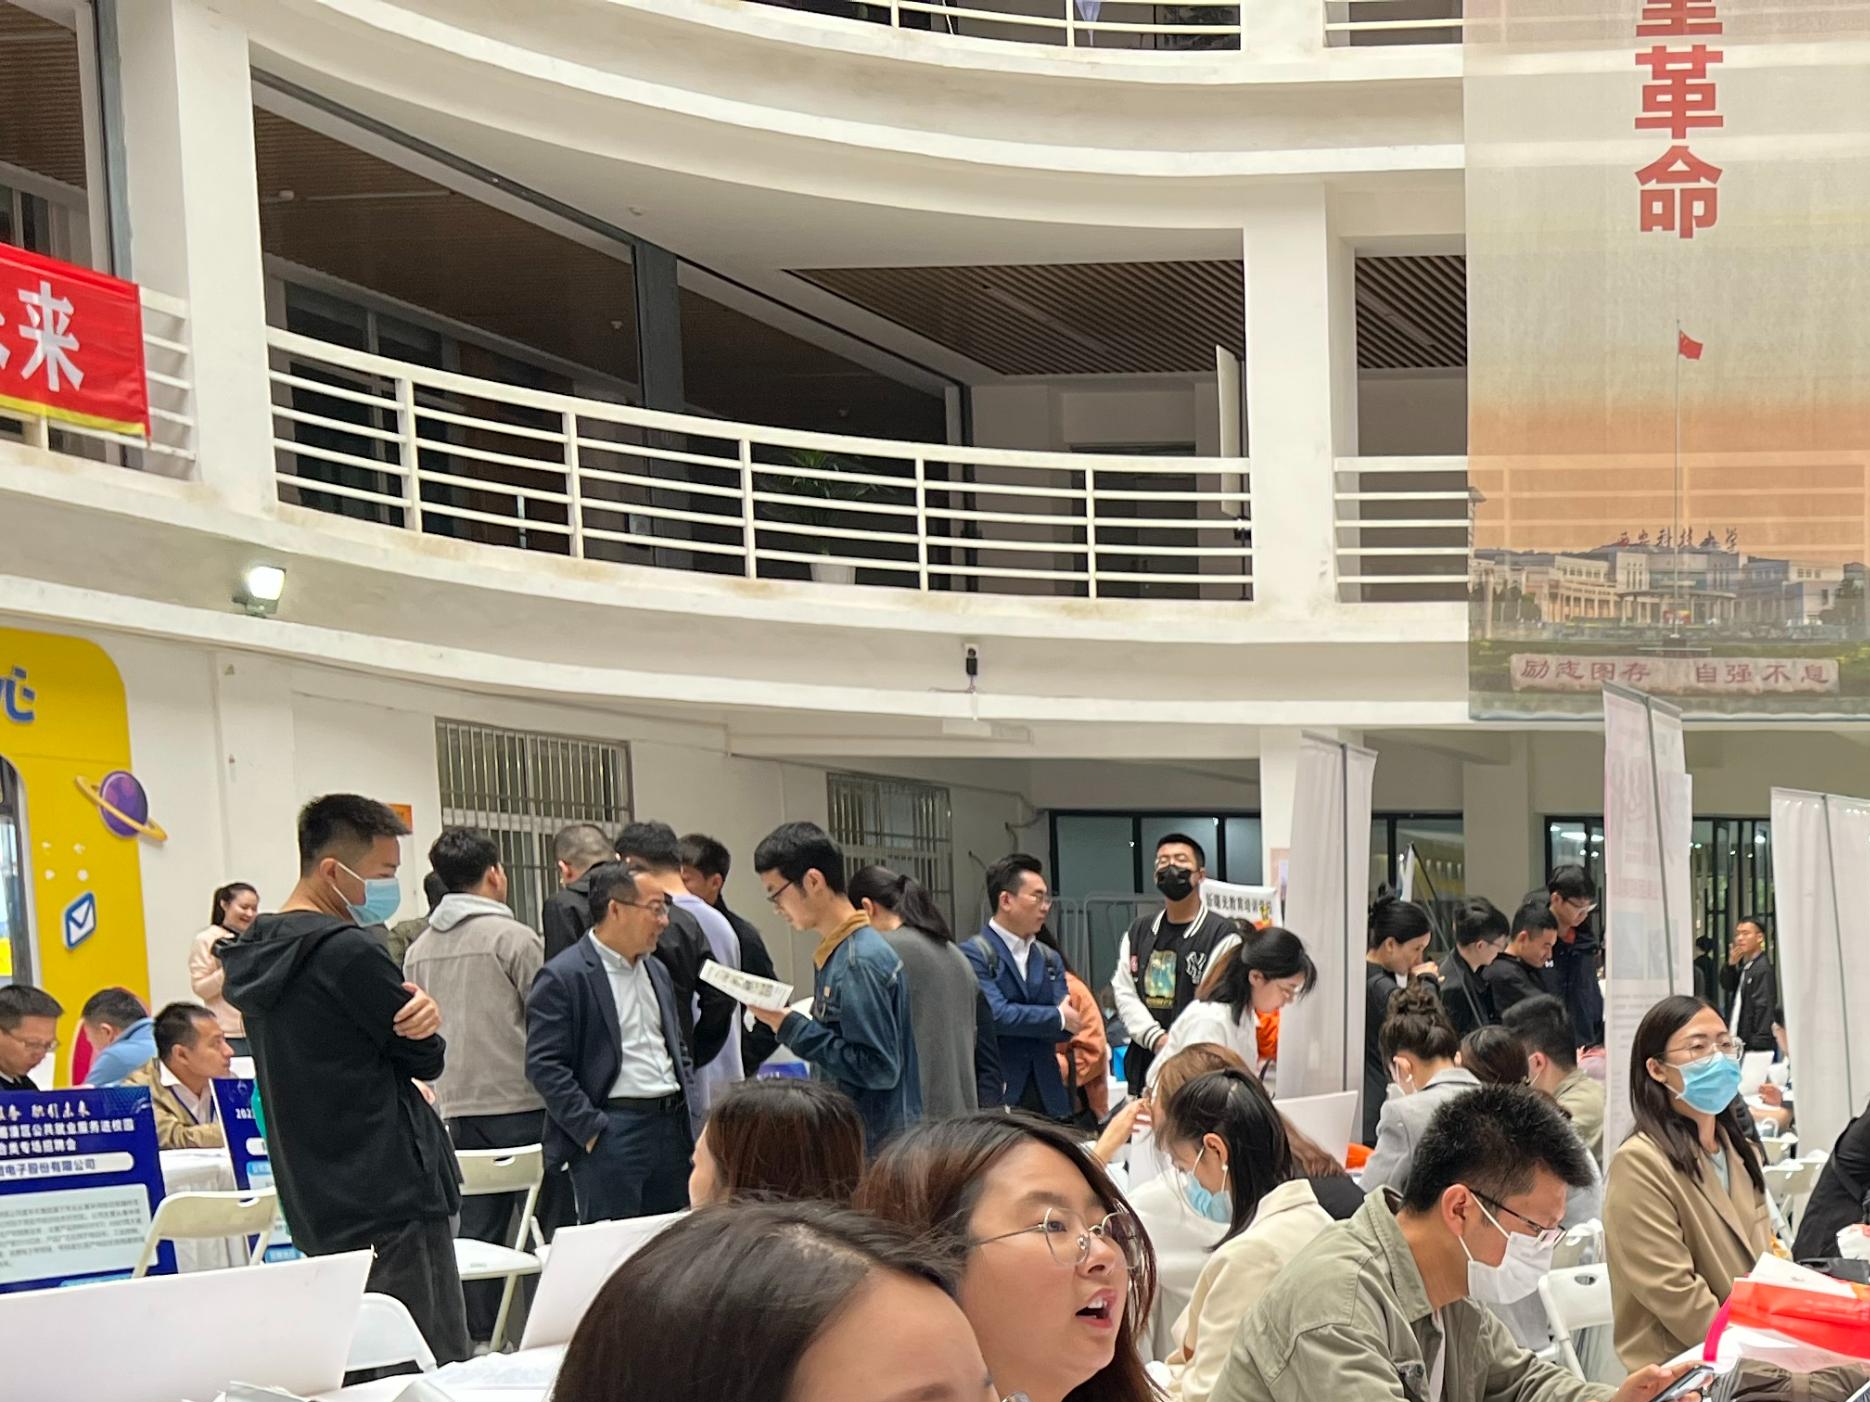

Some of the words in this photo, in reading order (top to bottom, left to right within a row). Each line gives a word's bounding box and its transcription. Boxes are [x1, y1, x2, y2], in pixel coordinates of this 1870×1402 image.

[0, 280, 85, 394] 来
[1519, 657, 1652, 684] 励志图存
[1695, 656, 1831, 685] 自强不息
